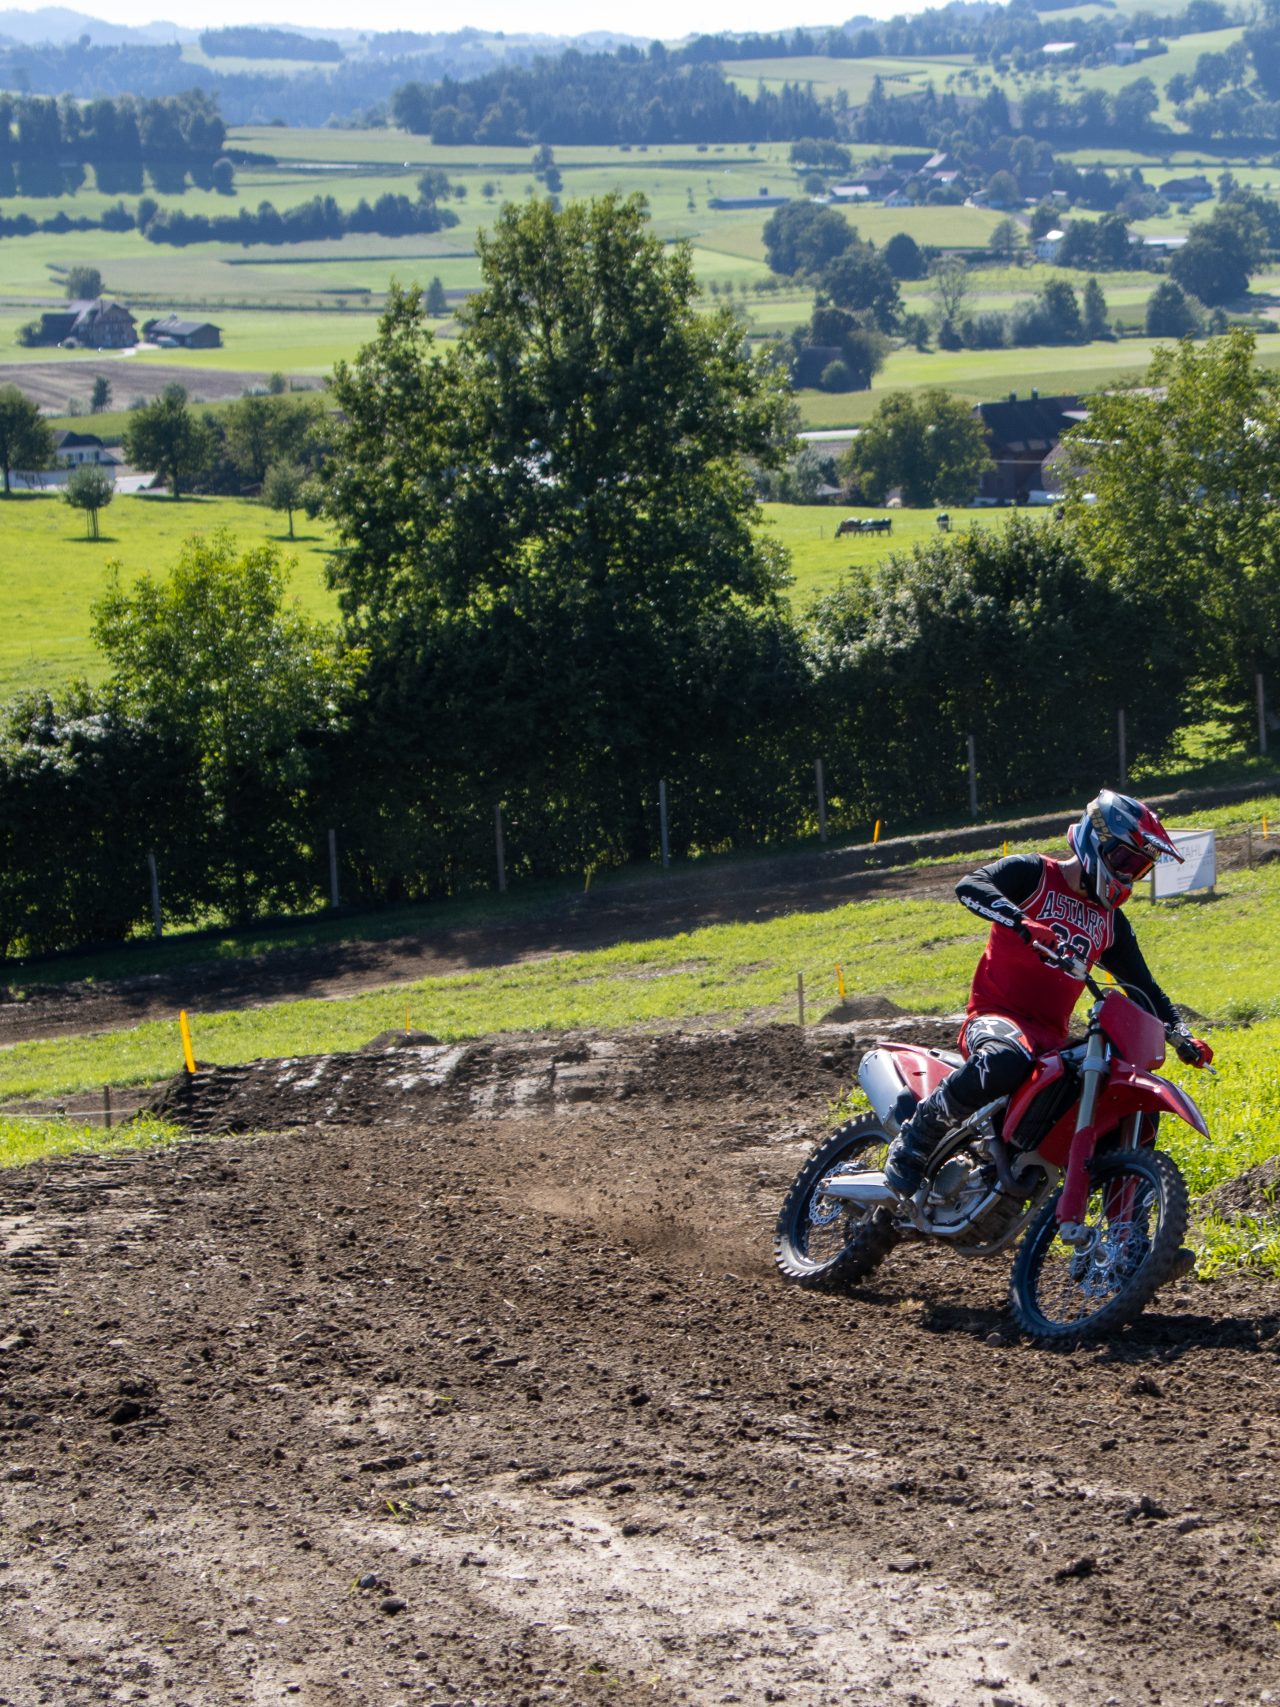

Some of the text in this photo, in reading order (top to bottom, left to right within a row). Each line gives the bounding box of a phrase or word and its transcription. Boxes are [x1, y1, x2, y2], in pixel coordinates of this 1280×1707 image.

[1180, 845, 1203, 857] TAHL
[960, 895, 1015, 927] alpinestars
[1036, 890, 1106, 950] ASTARS
